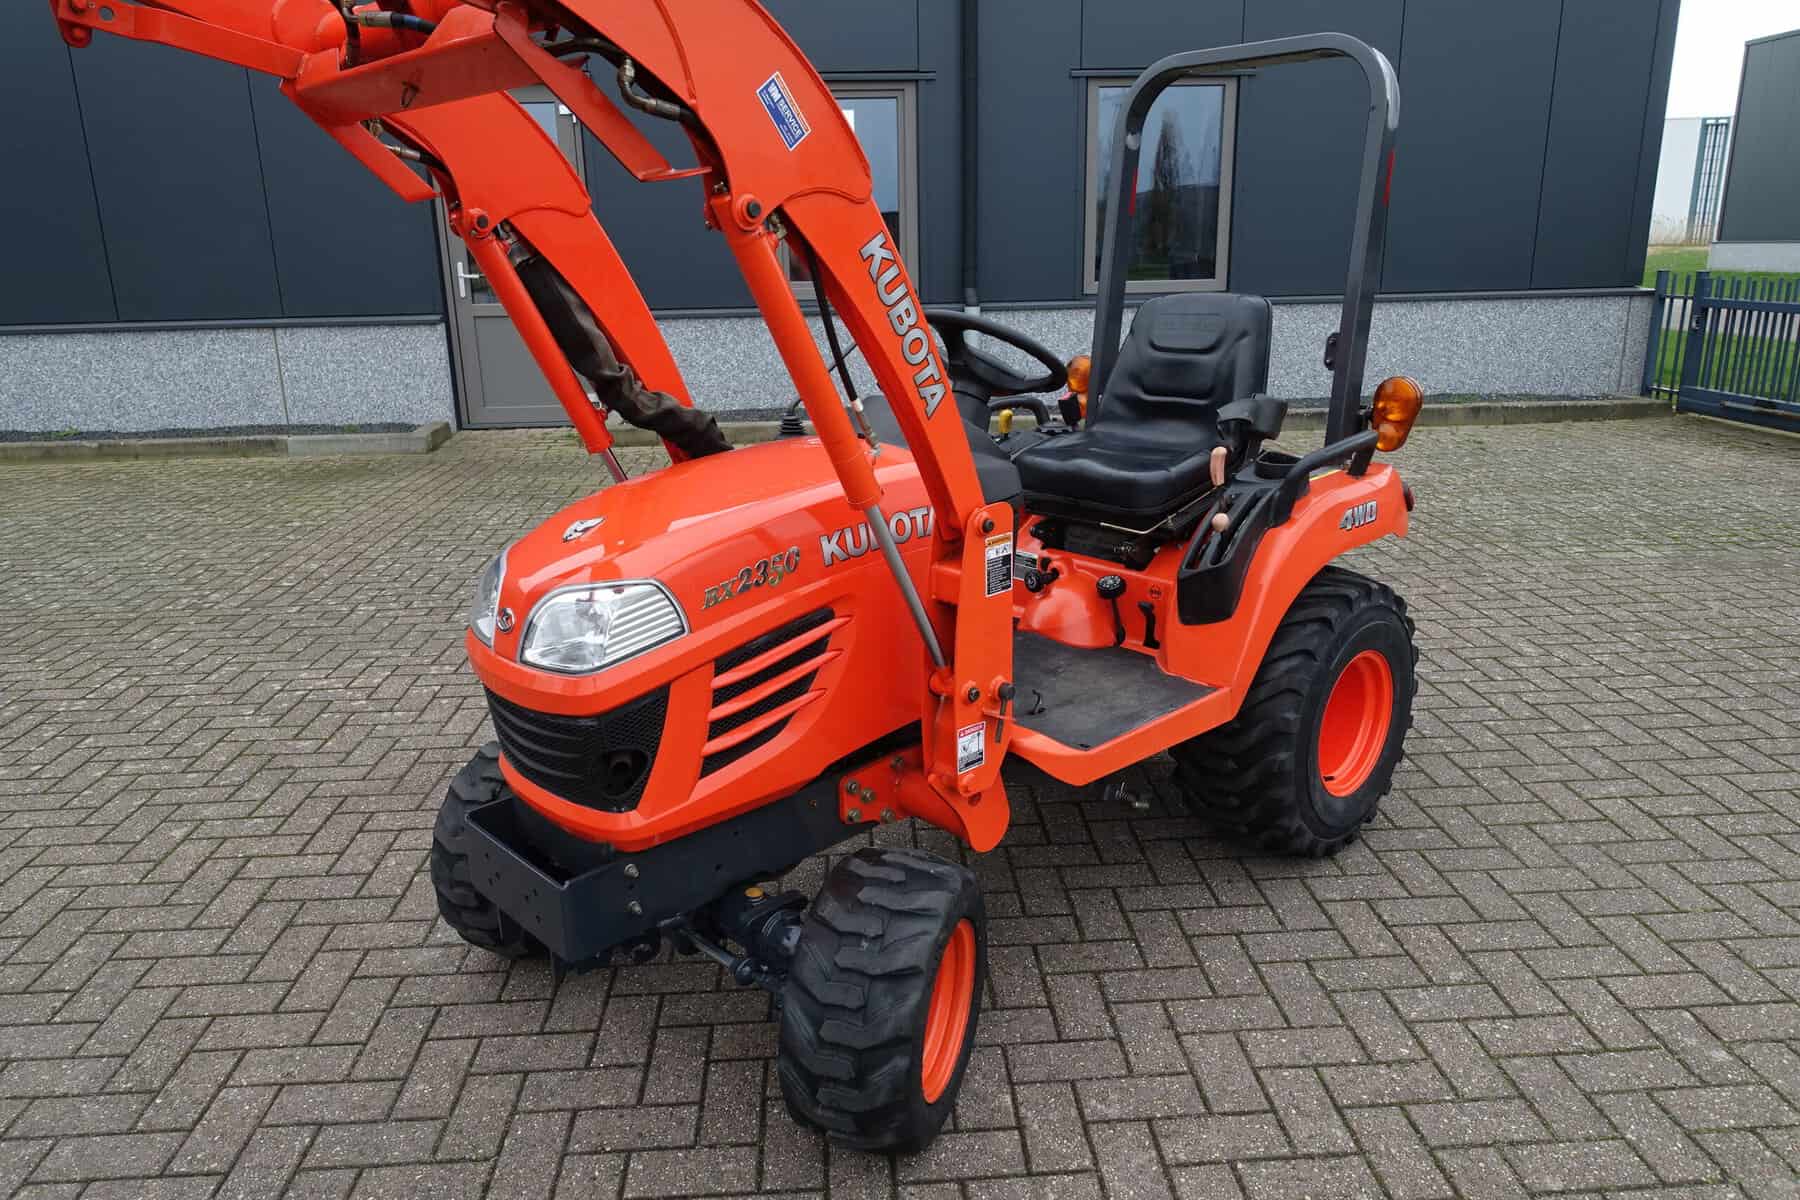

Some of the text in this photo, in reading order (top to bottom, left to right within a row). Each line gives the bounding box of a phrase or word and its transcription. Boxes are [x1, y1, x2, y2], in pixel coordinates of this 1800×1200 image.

[777, 98, 804, 139] SERVICE
[859, 231, 947, 421] KUBOTA
[819, 505, 936, 567] KUOT
[1339, 500, 1377, 531] 4WD
[701, 546, 801, 610] BX2350
